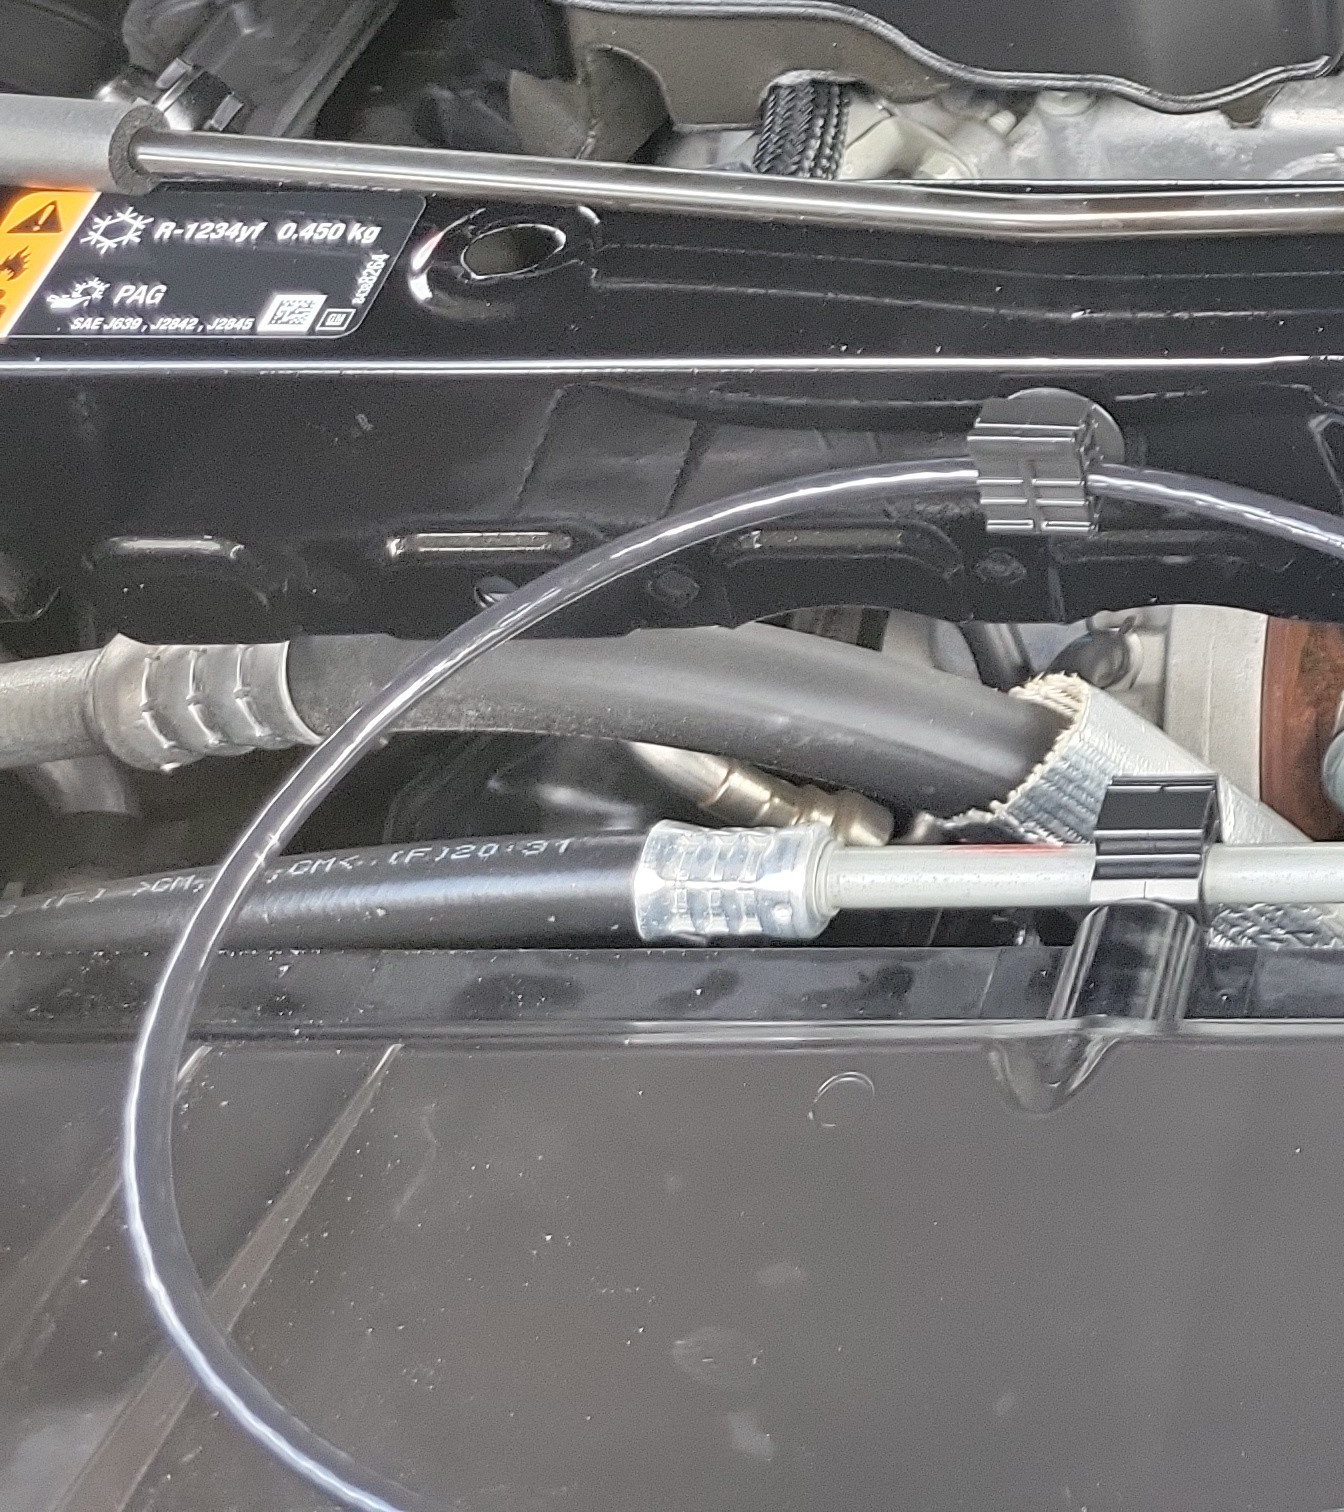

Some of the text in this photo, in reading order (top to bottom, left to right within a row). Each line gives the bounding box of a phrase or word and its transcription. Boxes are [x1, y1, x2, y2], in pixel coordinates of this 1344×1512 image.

[153, 220, 382, 246] R-1234yf 0.450 kg
[113, 285, 168, 305] PAG
[70, 317, 103, 330] SAE
[207, 318, 256, 330] J2845
